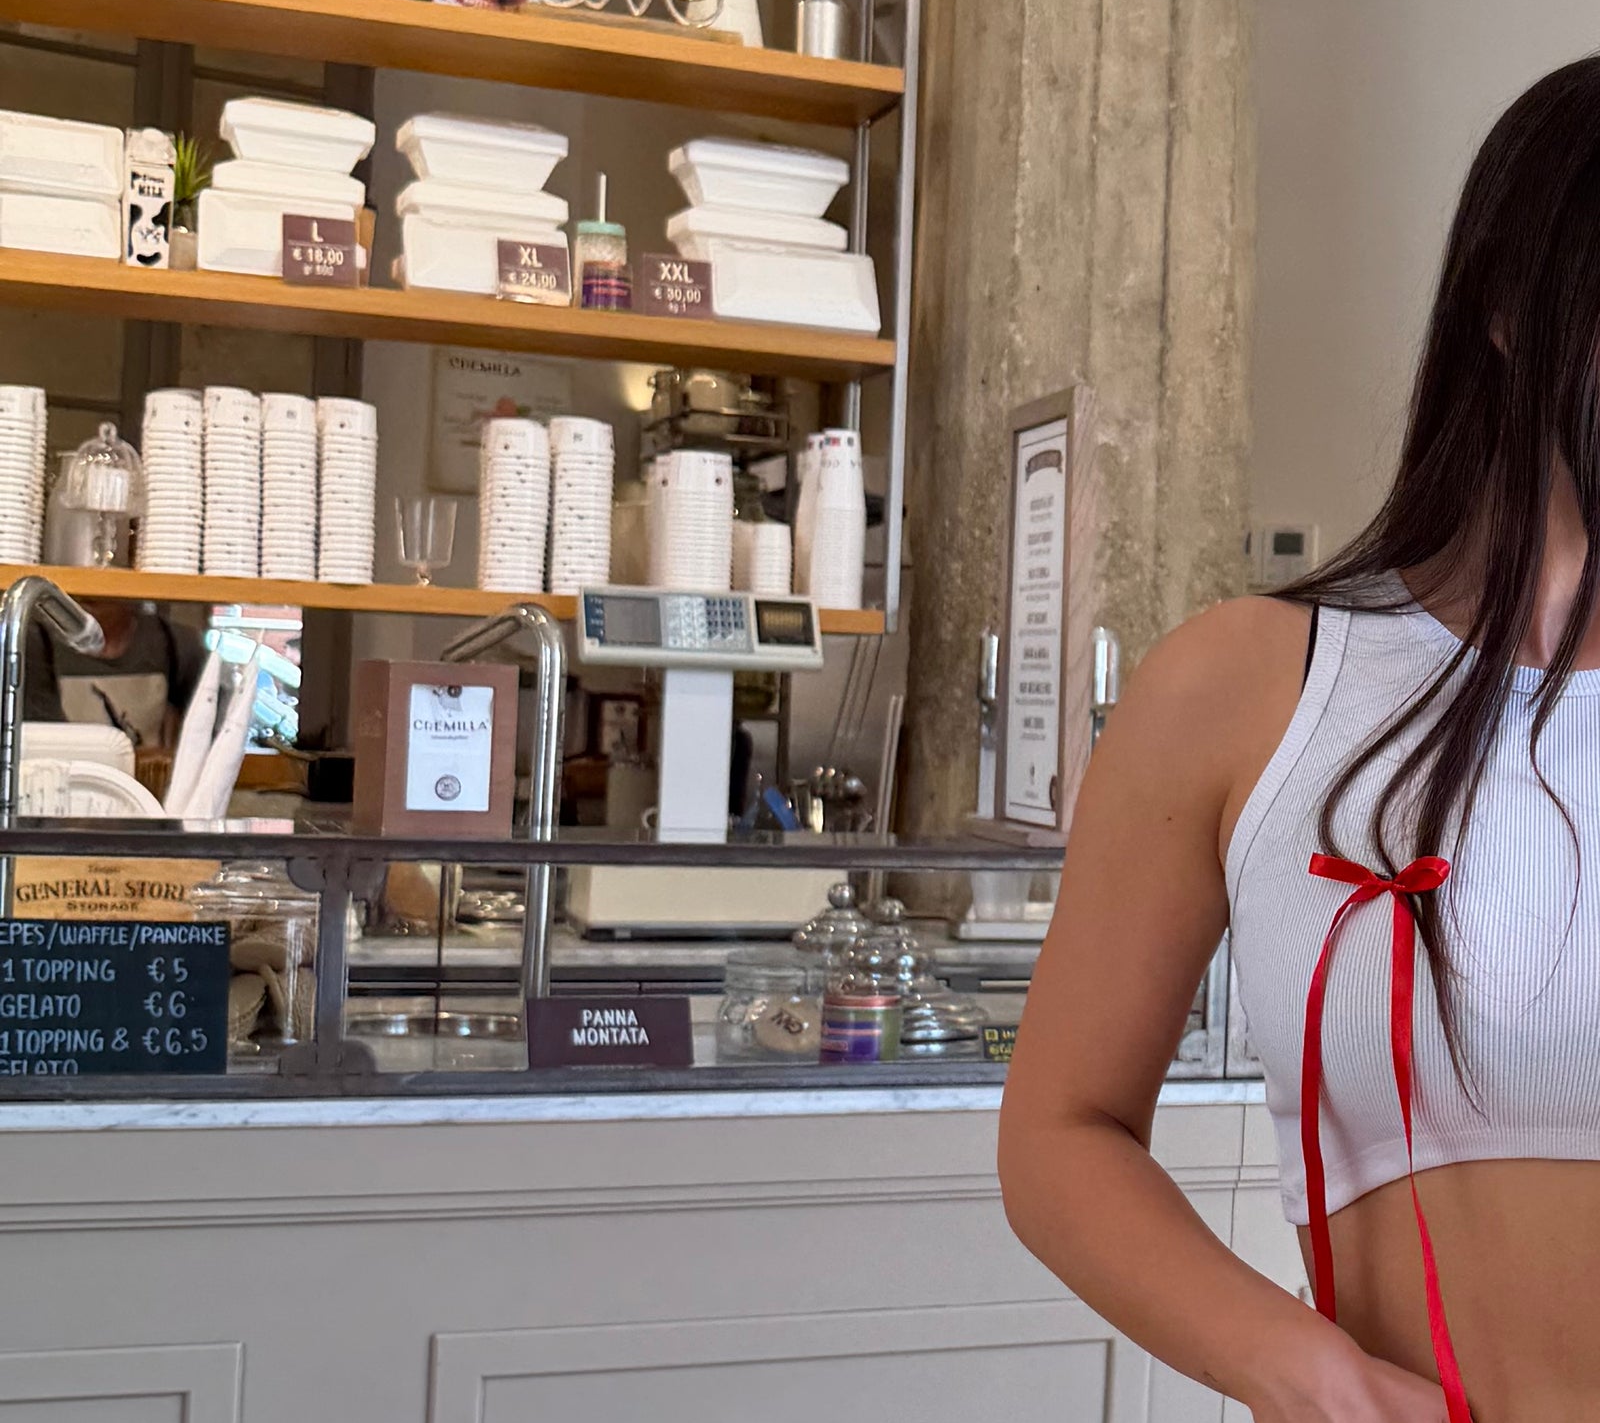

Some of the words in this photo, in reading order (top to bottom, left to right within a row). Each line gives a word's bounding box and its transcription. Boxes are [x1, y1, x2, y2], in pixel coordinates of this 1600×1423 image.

[311, 220, 324, 243] L
[292, 247, 303, 261] €
[306, 247, 344, 266] 18,00
[520, 245, 543, 268] XL
[508, 272, 517, 284] €
[521, 273, 557, 289] 24,00
[660, 262, 694, 284] XXL
[653, 287, 662, 299] €
[667, 287, 702, 304] 30,00
[413, 719, 488, 731] CREMILLA
[16, 879, 117, 902] GENERAL
[3, 958, 15, 982] 1
[22, 959, 116, 983] TOPPING
[1, 993, 81, 1019] GELATO
[582, 1009, 638, 1026] PANNA
[0, 1030, 10, 1055] 1
[16, 1028, 104, 1055] TOPPING
[111, 1027, 129, 1052] &
[572, 1027, 650, 1047] MONTATA
